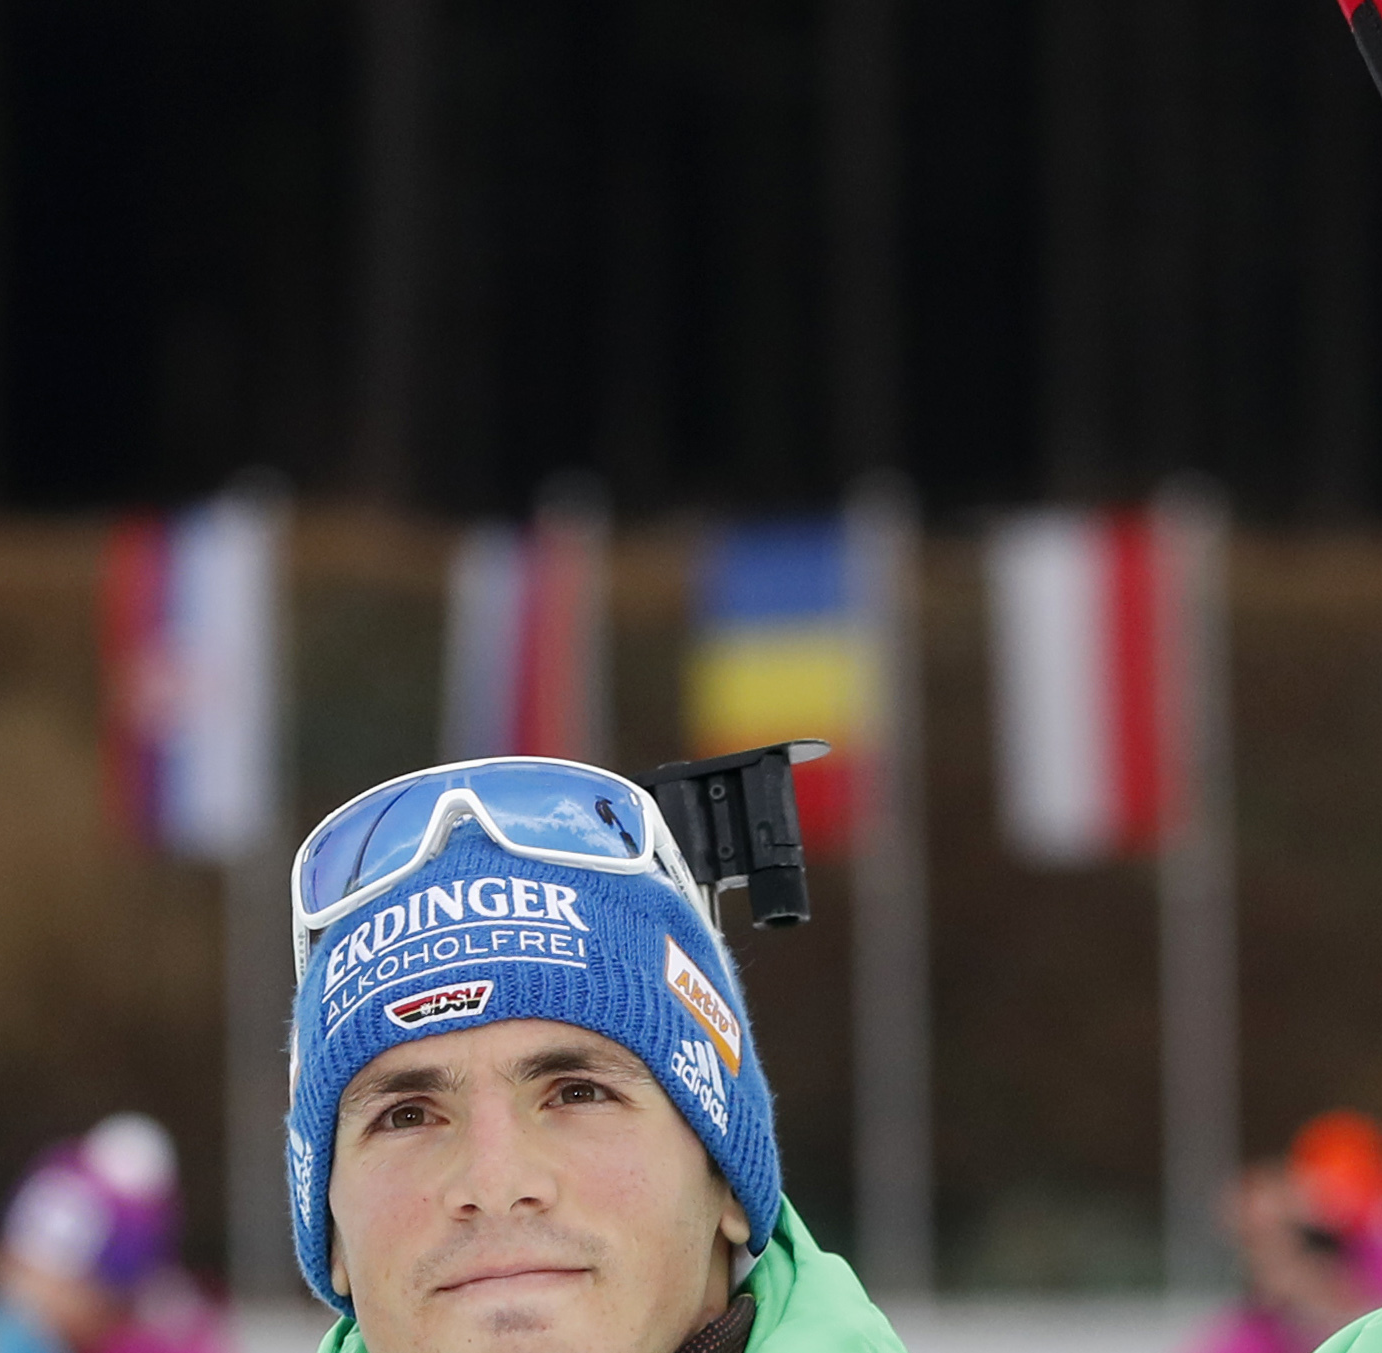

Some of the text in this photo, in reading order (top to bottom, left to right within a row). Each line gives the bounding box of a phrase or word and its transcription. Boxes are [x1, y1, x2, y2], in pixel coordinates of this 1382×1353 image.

[323, 876, 591, 995] ERDINGER
[326, 930, 586, 1026] ALKOHOLFREI
[435, 985, 488, 1016] DSV
[671, 1051, 728, 1137] adidas
